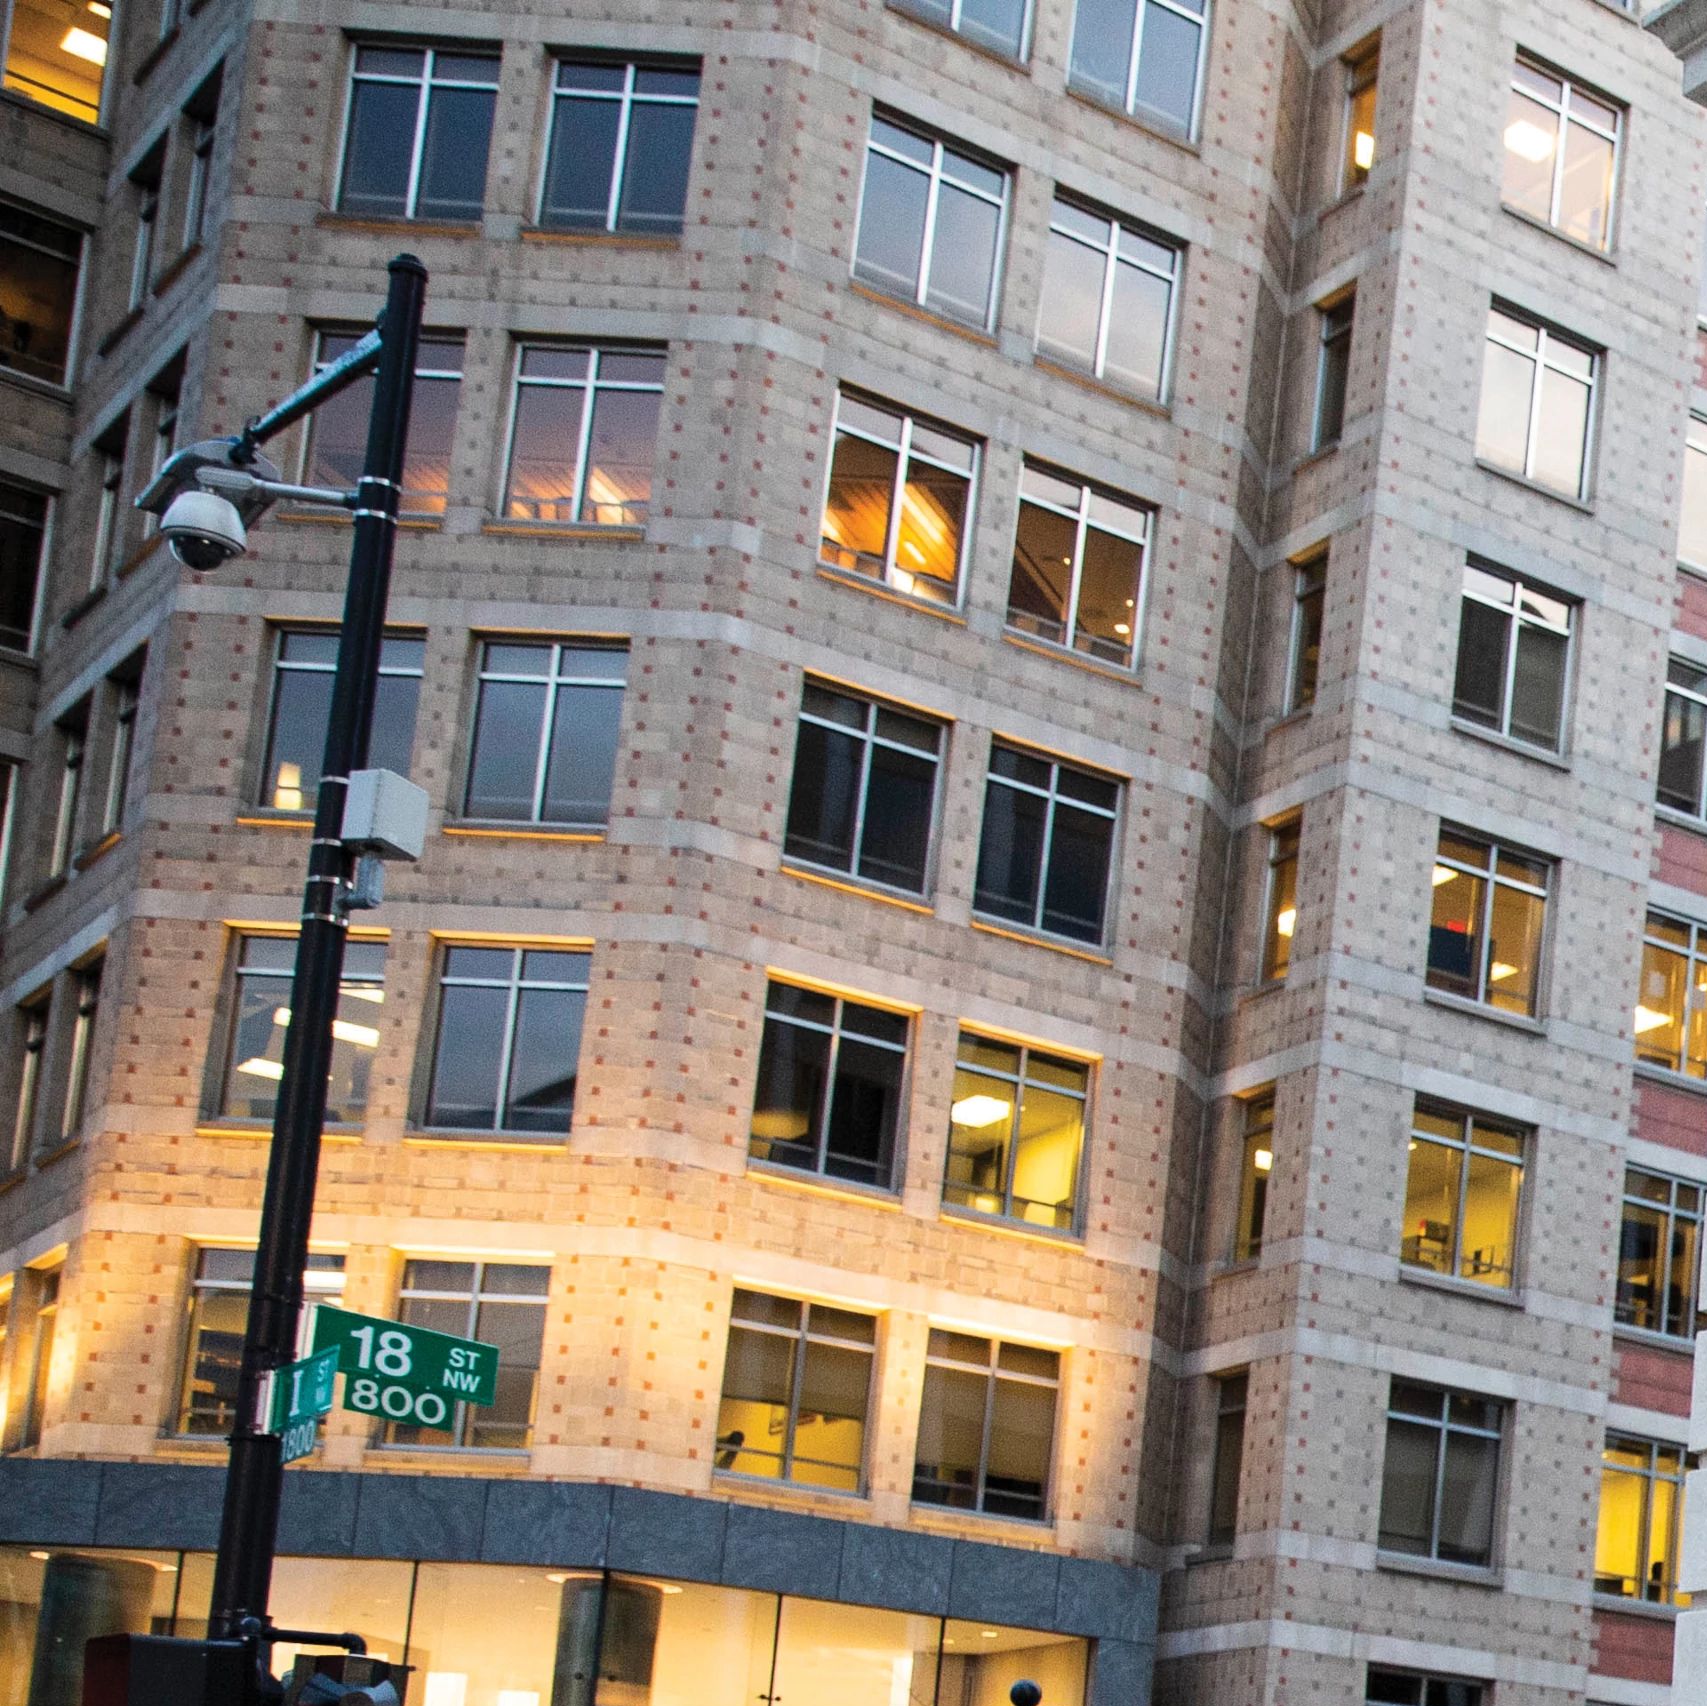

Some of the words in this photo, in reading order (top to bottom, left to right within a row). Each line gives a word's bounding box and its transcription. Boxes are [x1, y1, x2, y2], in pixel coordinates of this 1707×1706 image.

[350, 1325, 413, 1377] 18
[449, 1347, 482, 1370] ST
[289, 1369, 304, 1417] I
[351, 1379, 447, 1425] 800
[442, 1369, 481, 1393] NW
